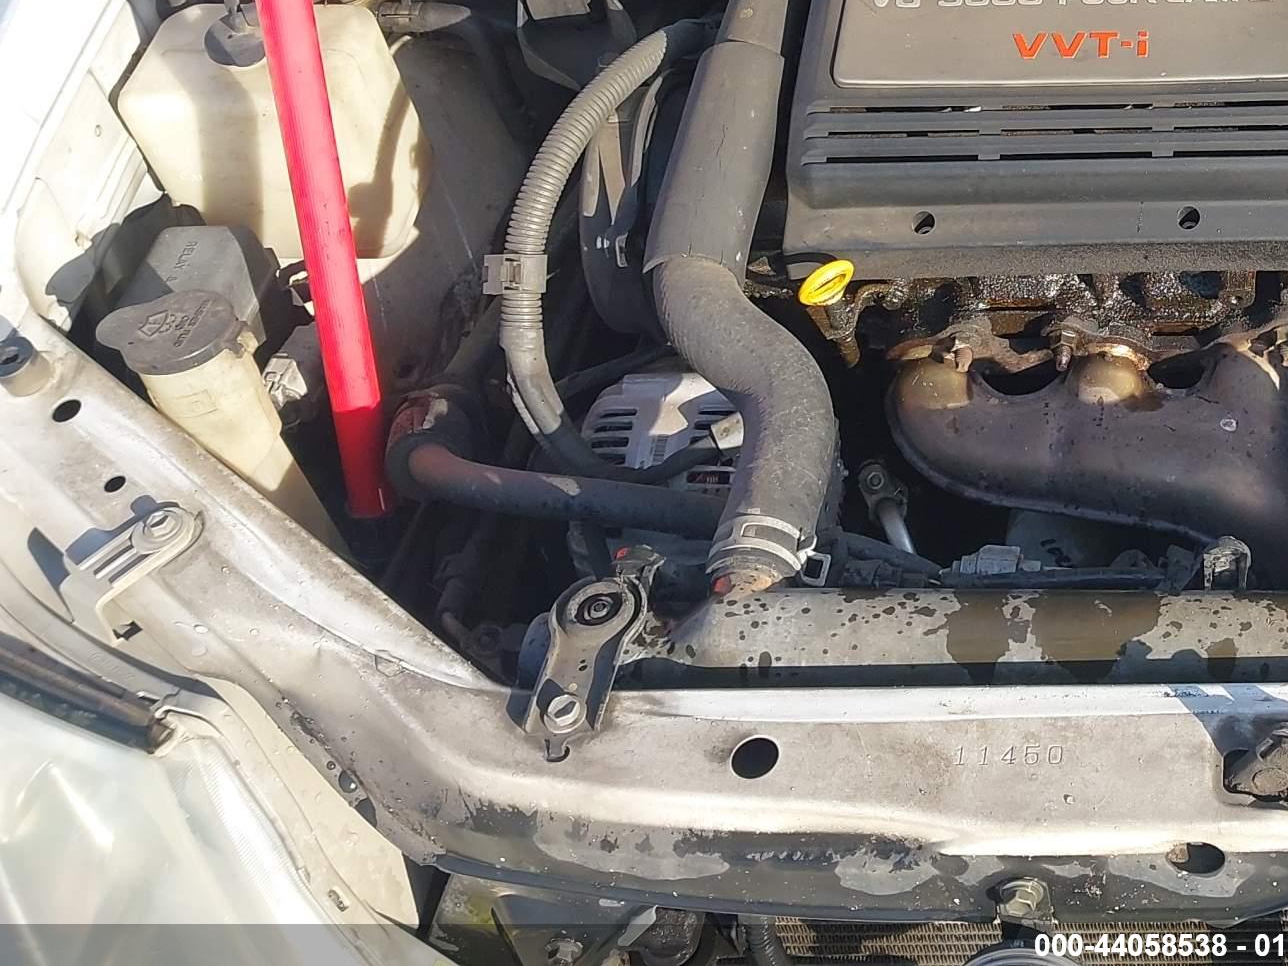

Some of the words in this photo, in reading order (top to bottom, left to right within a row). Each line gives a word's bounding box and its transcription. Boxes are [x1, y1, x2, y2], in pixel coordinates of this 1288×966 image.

[1012, 31, 1151, 60] VVT-i
[172, 241, 198, 270] RELAY
[954, 745, 1064, 766] 11450
